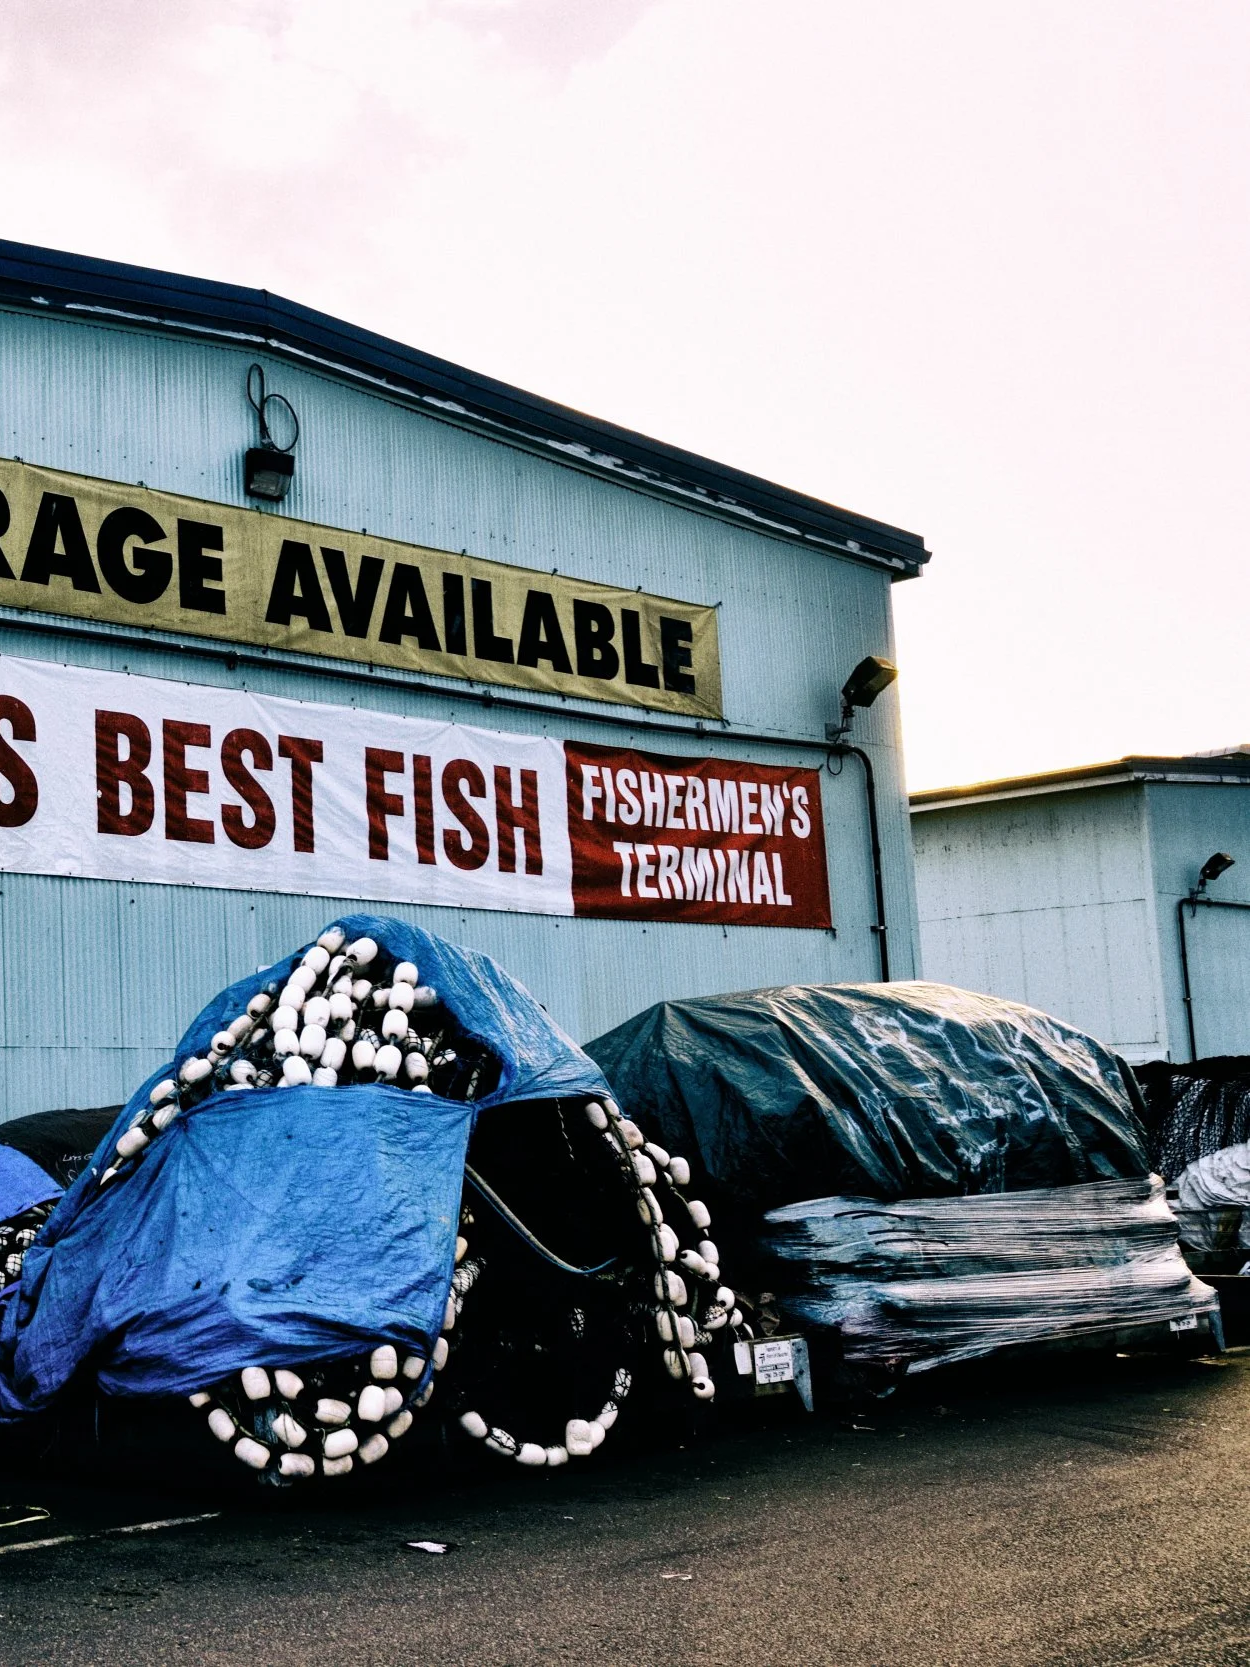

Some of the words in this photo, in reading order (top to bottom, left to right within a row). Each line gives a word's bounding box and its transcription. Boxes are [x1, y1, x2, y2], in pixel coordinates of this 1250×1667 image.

[265, 539, 696, 694] AVAILABLE
[95, 709, 323, 852] BEST
[365, 747, 543, 876] FISH
[580, 764, 811, 838] FISHERMEN'S
[613, 842, 792, 906] TERMINAL
